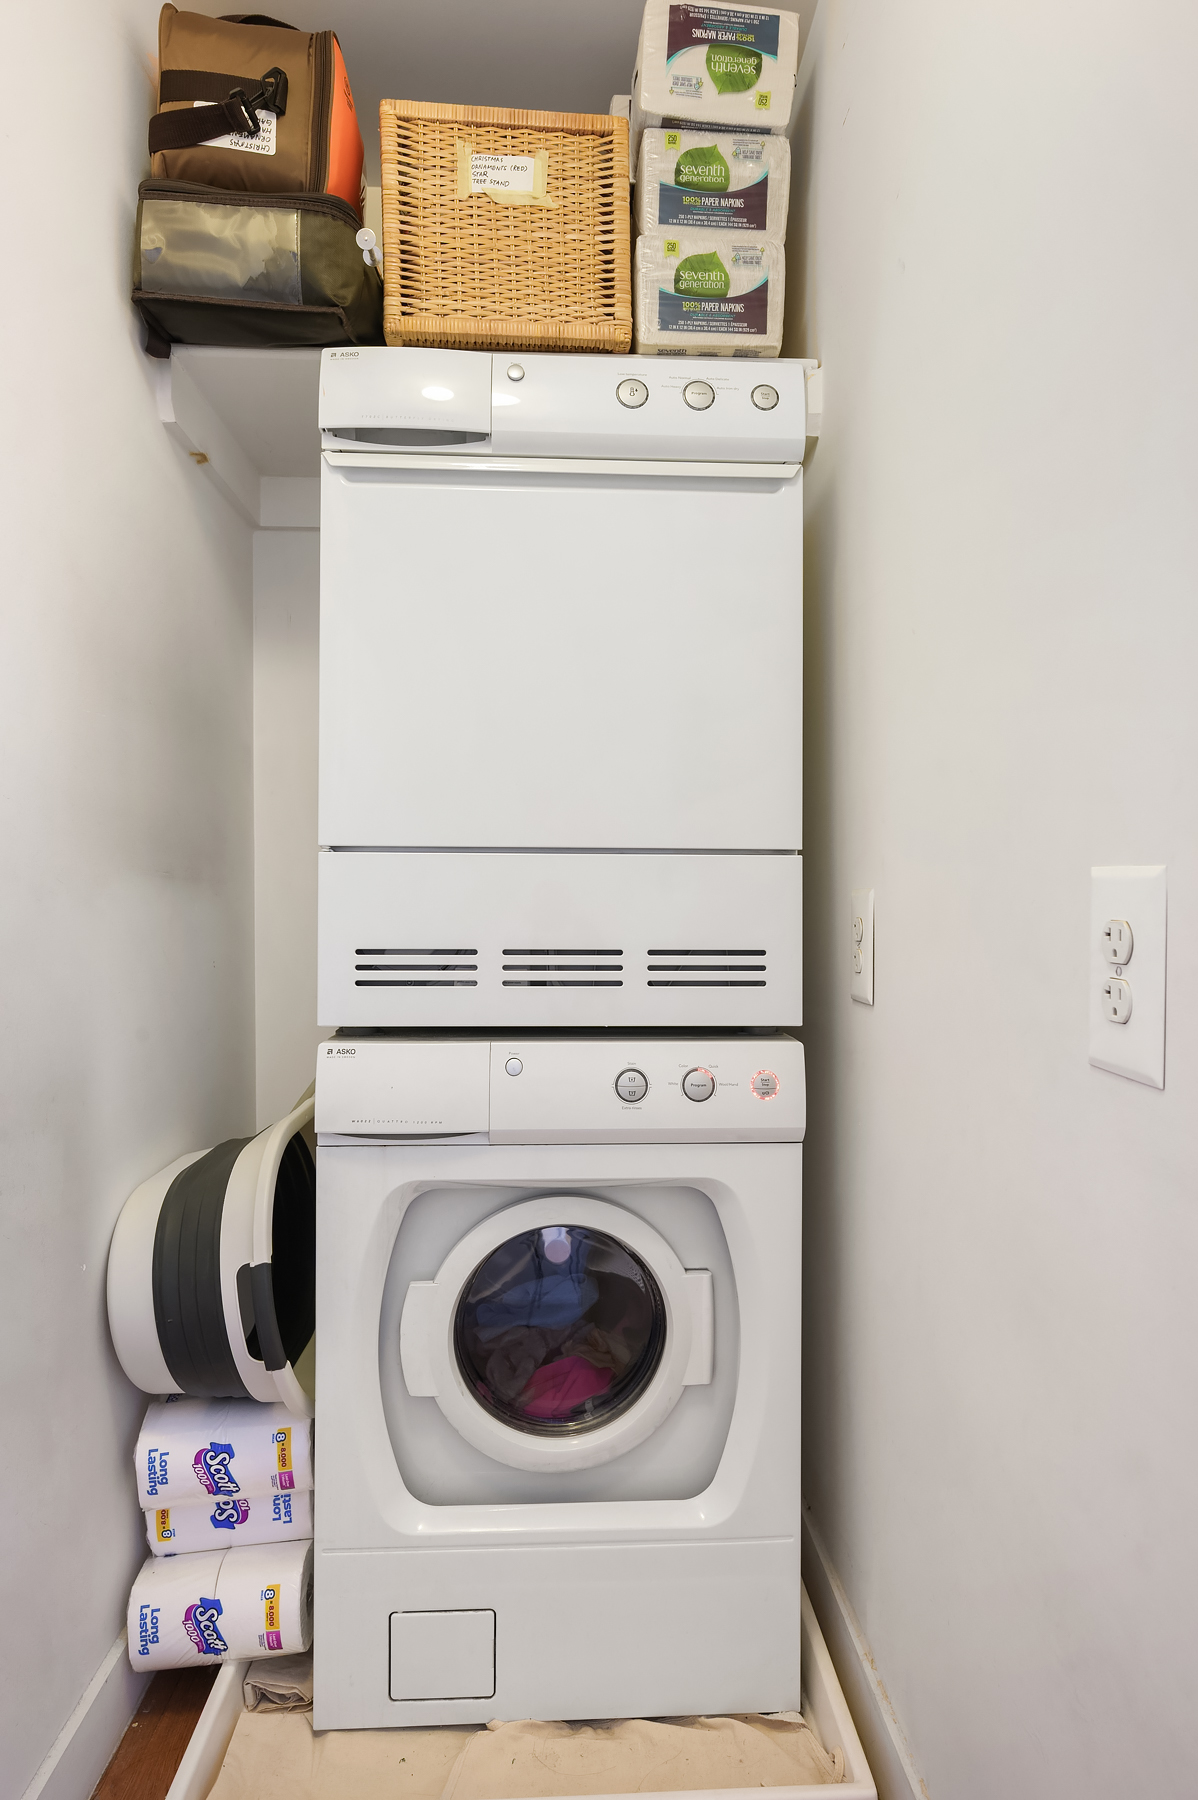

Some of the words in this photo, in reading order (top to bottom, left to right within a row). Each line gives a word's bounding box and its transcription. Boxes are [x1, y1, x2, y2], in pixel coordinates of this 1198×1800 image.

[692, 29, 716, 39] NAPKINS
[717, 32, 735, 41] PAPER
[711, 54, 757, 66] generation
[711, 62, 756, 74] seventh
[680, 164, 724, 177] seventh
[490, 178, 510, 187] STAND
[680, 175, 725, 183] generation
[701, 197, 719, 206] PAPER
[721, 197, 744, 208] NAPKINS
[667, 242, 676, 250] 250
[680, 270, 724, 281] seventh
[679, 279, 725, 289] generation
[701, 302, 719, 312] PAPER
[721, 303, 744, 313] NAPKINS
[276, 1432, 286, 1443] 8
[147, 1448, 158, 1496] Lasting
[159, 1452, 169, 1486] Long
[192, 1463, 211, 1486] 1000
[205, 1451, 241, 1493] Scott
[272, 1494, 281, 1521] Lon
[283, 1494, 292, 1524] Lasti
[162, 1529, 172, 1538] 8
[264, 1588, 275, 1600] 8
[138, 1604, 150, 1656] Lasting
[150, 1608, 160, 1644] Long
[182, 1620, 200, 1643] 1000
[195, 1607, 228, 1651] Scott
